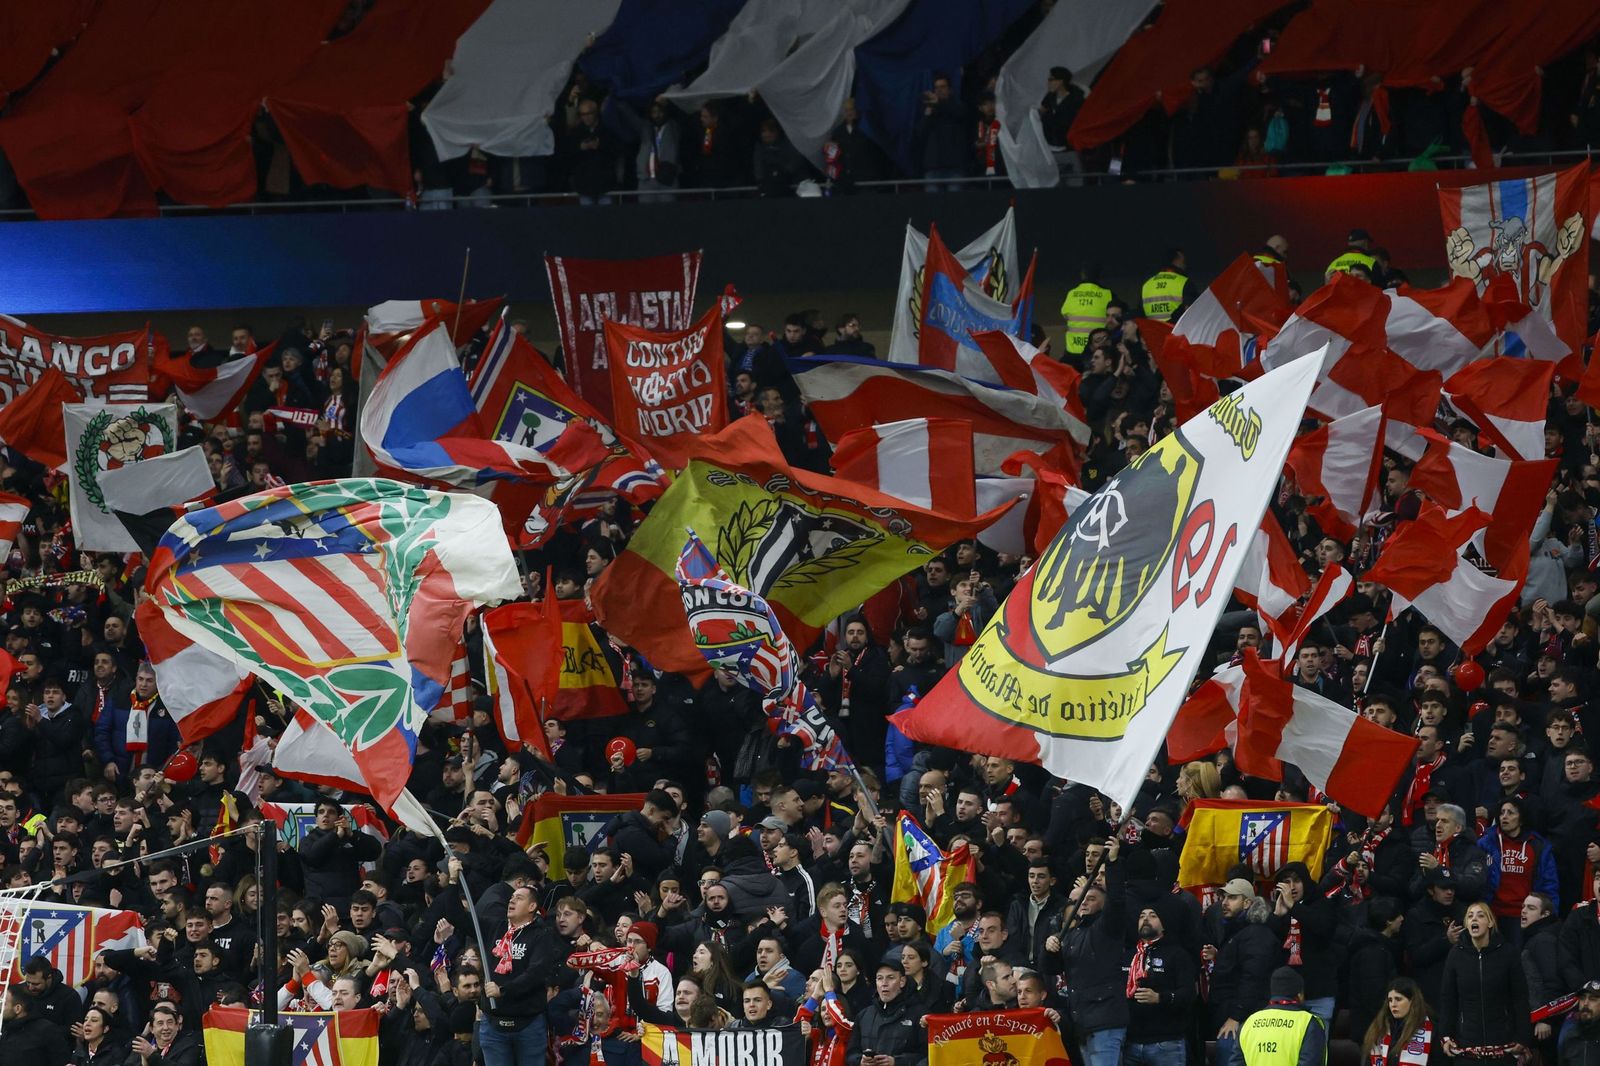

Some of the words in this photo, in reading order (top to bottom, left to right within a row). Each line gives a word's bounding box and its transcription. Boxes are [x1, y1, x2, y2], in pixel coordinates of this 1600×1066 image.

[1151, 303, 1171, 313] ARIETE
[1072, 336, 1089, 347] ARIE
[0, 329, 136, 377] LANCO
[1502, 864, 1524, 874] ADRID
[1252, 1018, 1295, 1028] SEGURIDAD
[933, 1014, 973, 1048] Reinaré
[976, 1016, 991, 1026] en
[993, 1013, 1044, 1041] España
[1258, 1042, 1278, 1053] 1182
